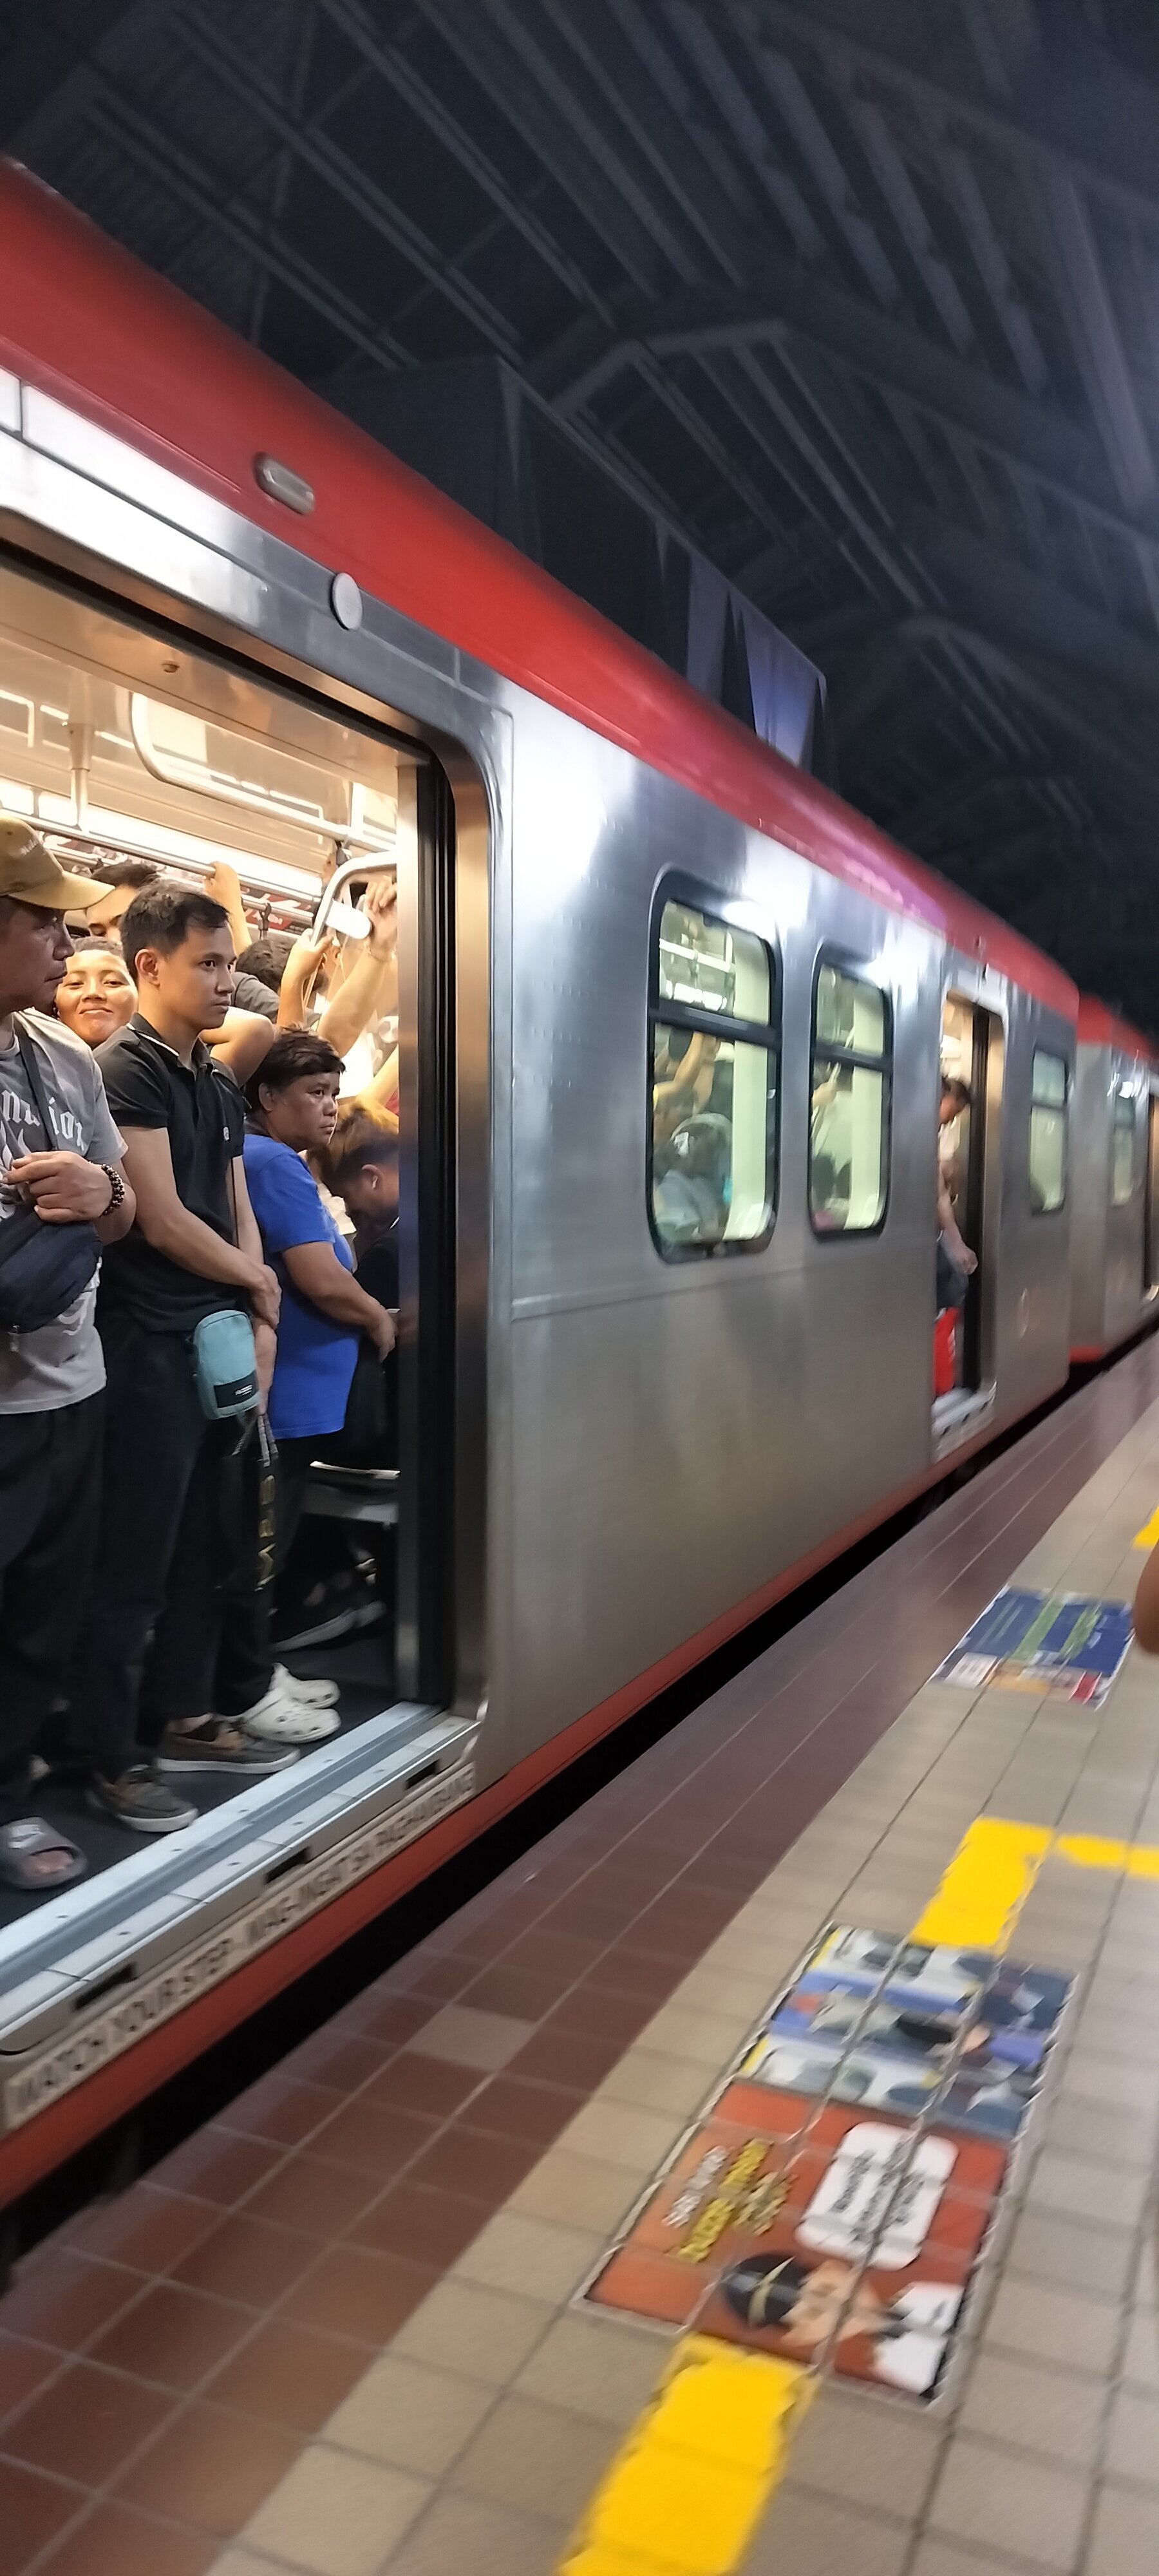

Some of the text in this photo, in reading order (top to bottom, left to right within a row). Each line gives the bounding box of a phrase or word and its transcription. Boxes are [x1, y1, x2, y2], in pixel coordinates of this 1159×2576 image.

[6, 2025, 108, 2114] WATCH
[109, 1977, 178, 2041] YOUR
[179, 1940, 233, 1998] STEP
